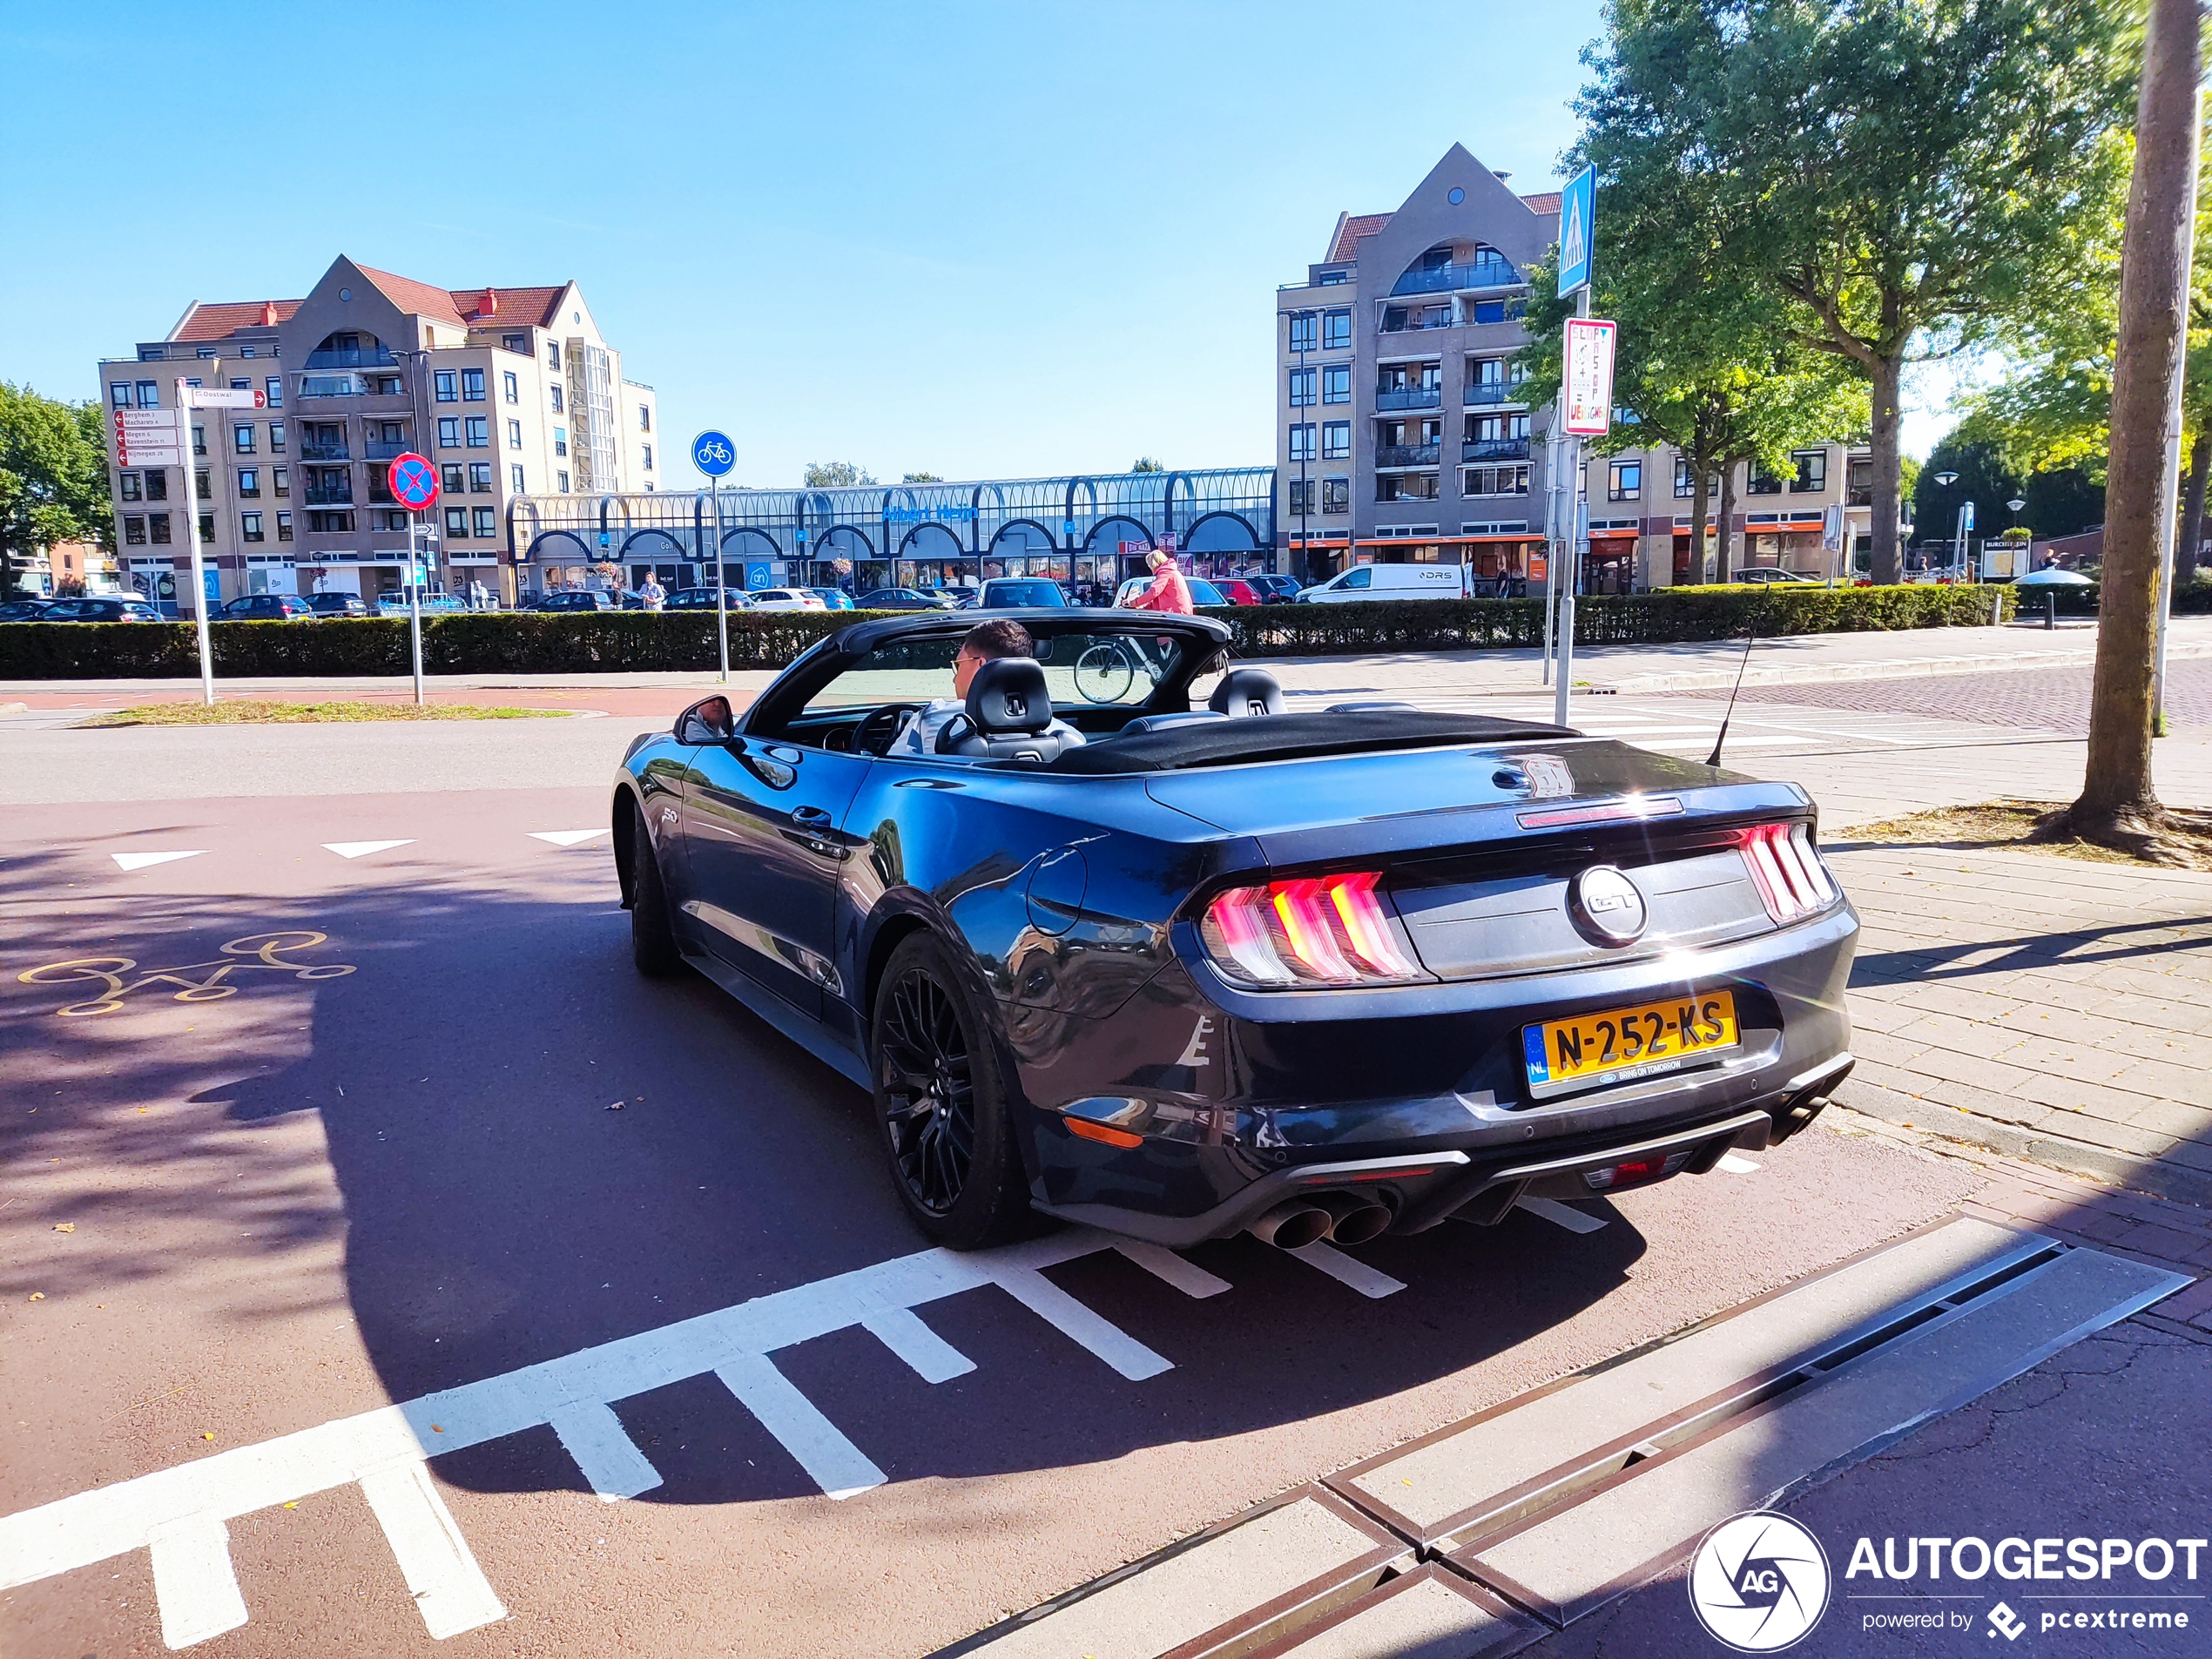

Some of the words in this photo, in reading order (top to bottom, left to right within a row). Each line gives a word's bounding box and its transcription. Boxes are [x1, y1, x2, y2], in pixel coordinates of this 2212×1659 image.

[882, 505, 930, 521] Albert
[936, 503, 978, 522] Heijn
[1588, 894, 1636, 914] GT
[1556, 1001, 1723, 1071] N-252-KS
[1531, 1062, 1547, 1076] NL
[1619, 1068, 1637, 1080] BRING
[1637, 1065, 1647, 1076] ON
[1647, 1060, 1681, 1074] TOMORROW
